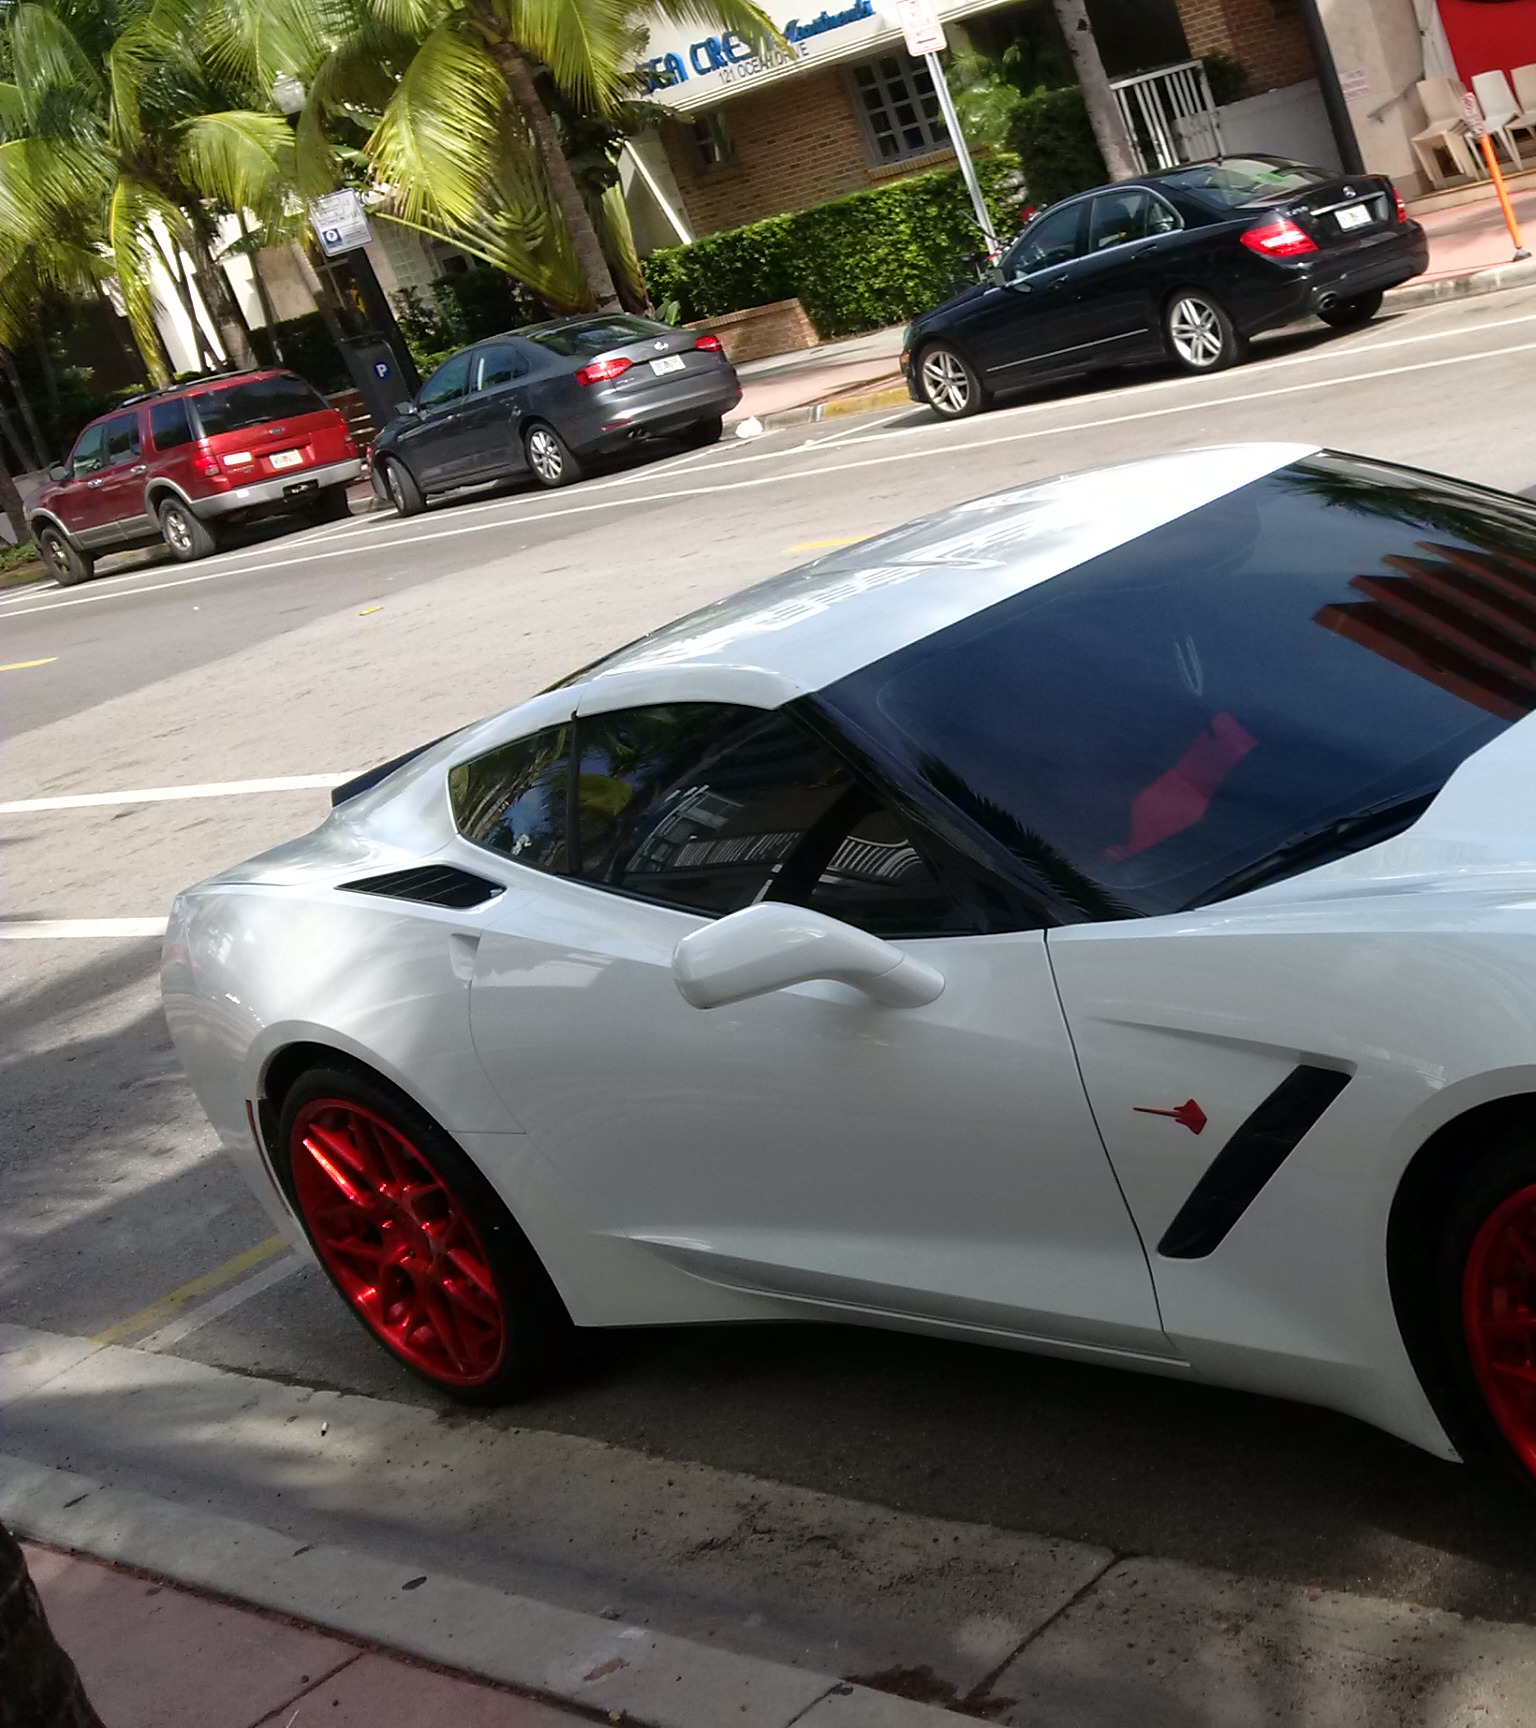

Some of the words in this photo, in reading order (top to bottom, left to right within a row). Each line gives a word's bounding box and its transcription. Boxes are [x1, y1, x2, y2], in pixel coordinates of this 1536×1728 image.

[718, 69, 737, 85] 121
[775, 42, 810, 67] DRVE
[375, 363, 388, 378] P
